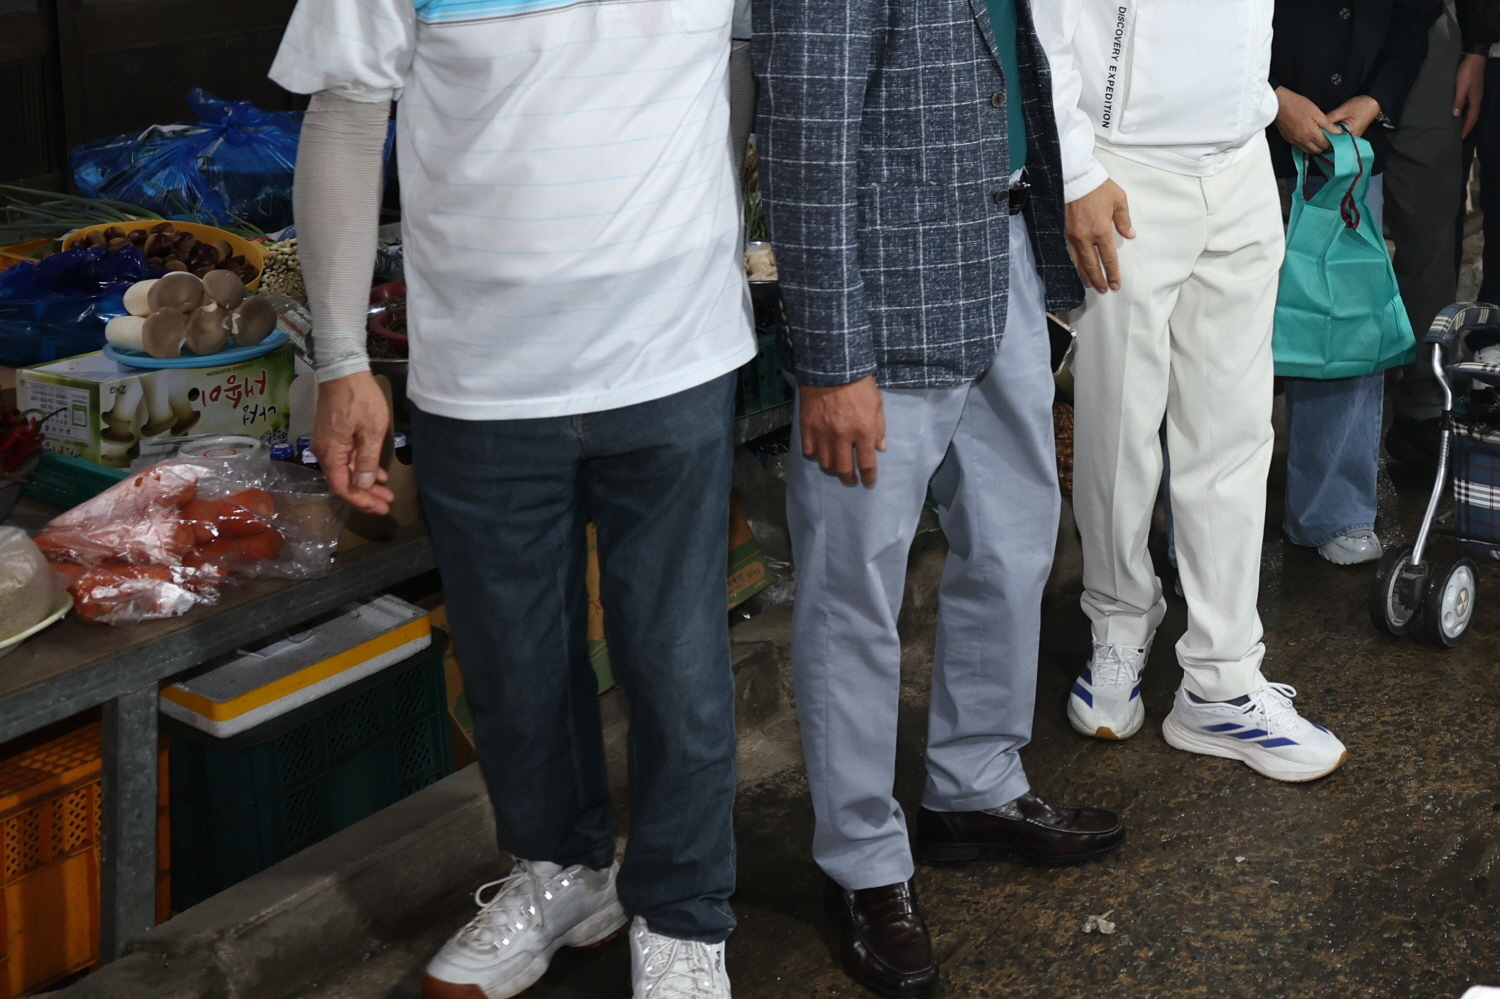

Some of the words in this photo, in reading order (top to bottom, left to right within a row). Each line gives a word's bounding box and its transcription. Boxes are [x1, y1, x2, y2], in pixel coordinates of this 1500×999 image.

[1111, 5, 1127, 62] DISCOVERY
[1102, 65, 1117, 129] EXPEDITION
[202, 369, 268, 410] 새송이
